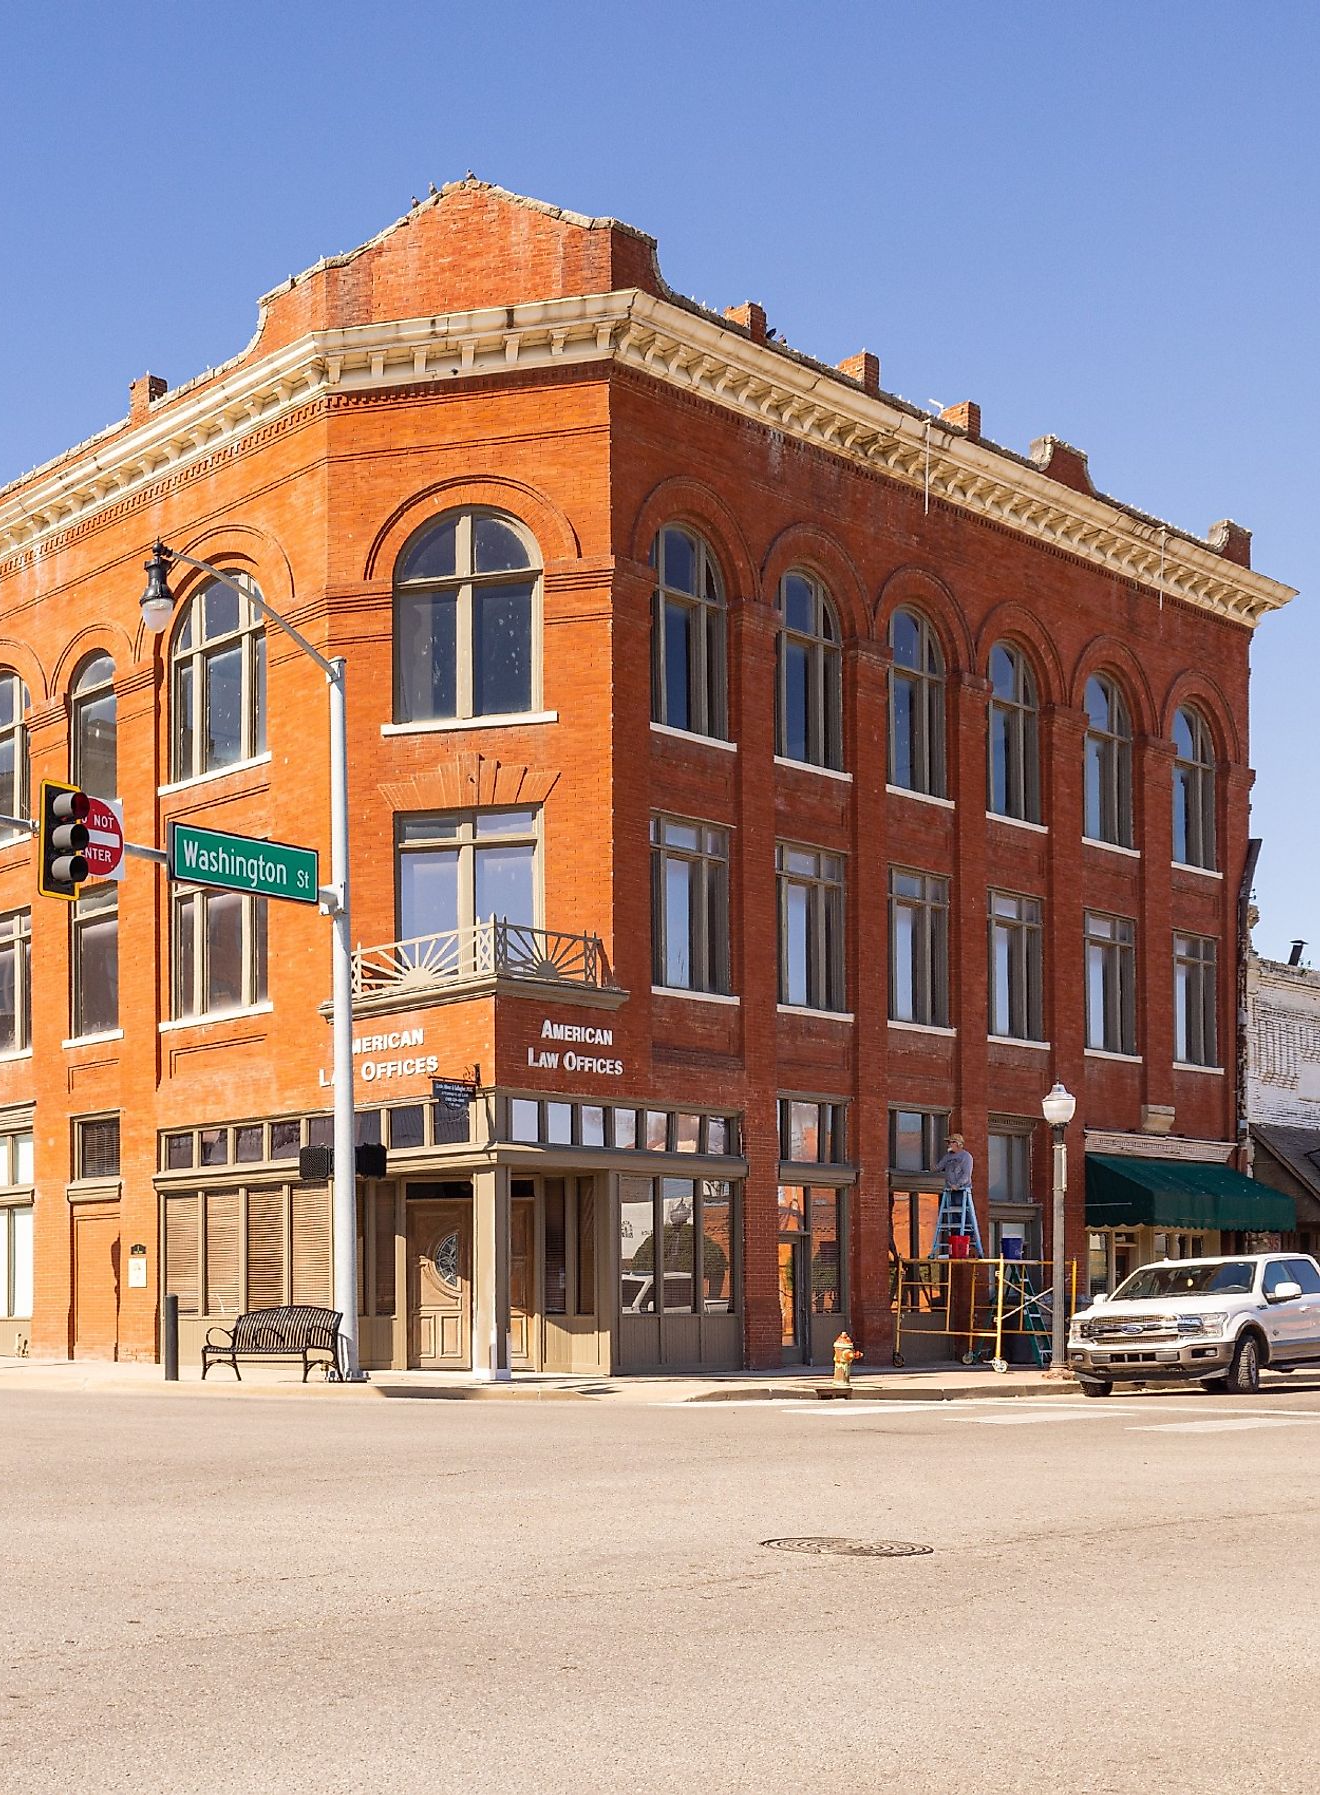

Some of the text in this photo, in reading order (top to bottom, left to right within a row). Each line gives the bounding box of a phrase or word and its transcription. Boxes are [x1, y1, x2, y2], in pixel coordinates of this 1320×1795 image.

[93, 814, 114, 829] NOT
[183, 839, 310, 889] Washington St
[352, 1028, 424, 1054] MERICAN
[540, 1019, 613, 1046] AMERICAN
[361, 1056, 439, 1082] OFFICES
[527, 1047, 624, 1075] LAW OFFICES
